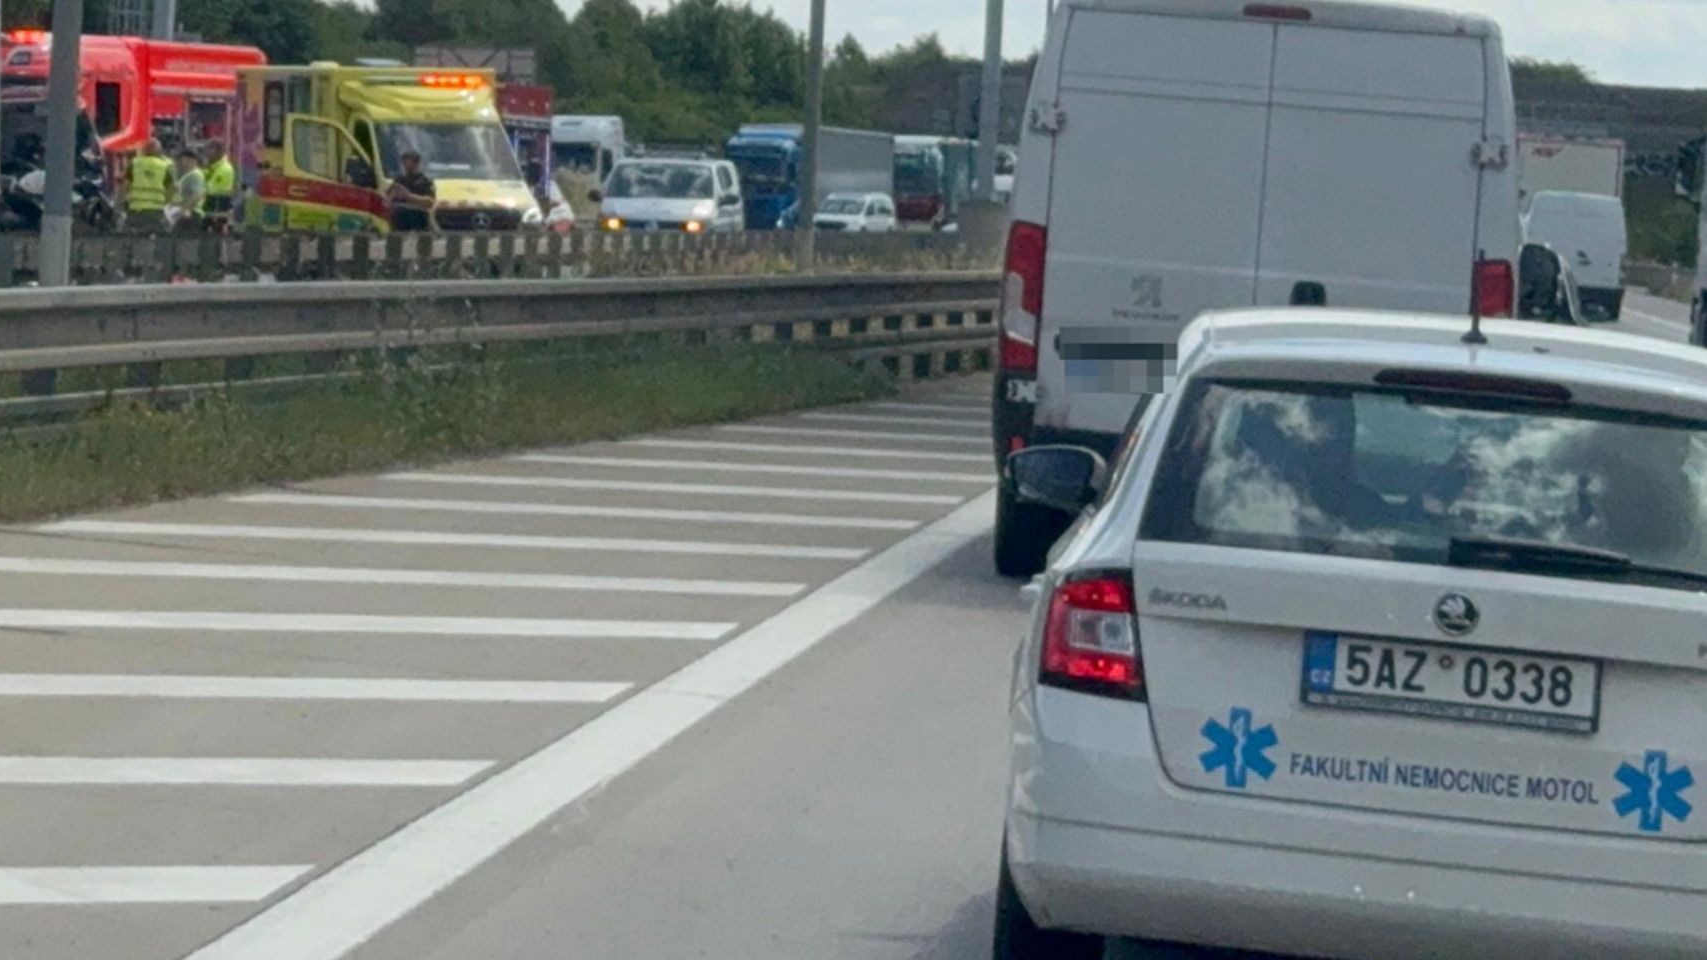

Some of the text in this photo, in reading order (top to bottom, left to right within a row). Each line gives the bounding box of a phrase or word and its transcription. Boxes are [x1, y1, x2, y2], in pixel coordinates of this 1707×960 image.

[1345, 644, 1573, 708] 5AZ 0338
[1289, 752, 1599, 805] FAKULTNÍ NEMOCNICE MOTOL
